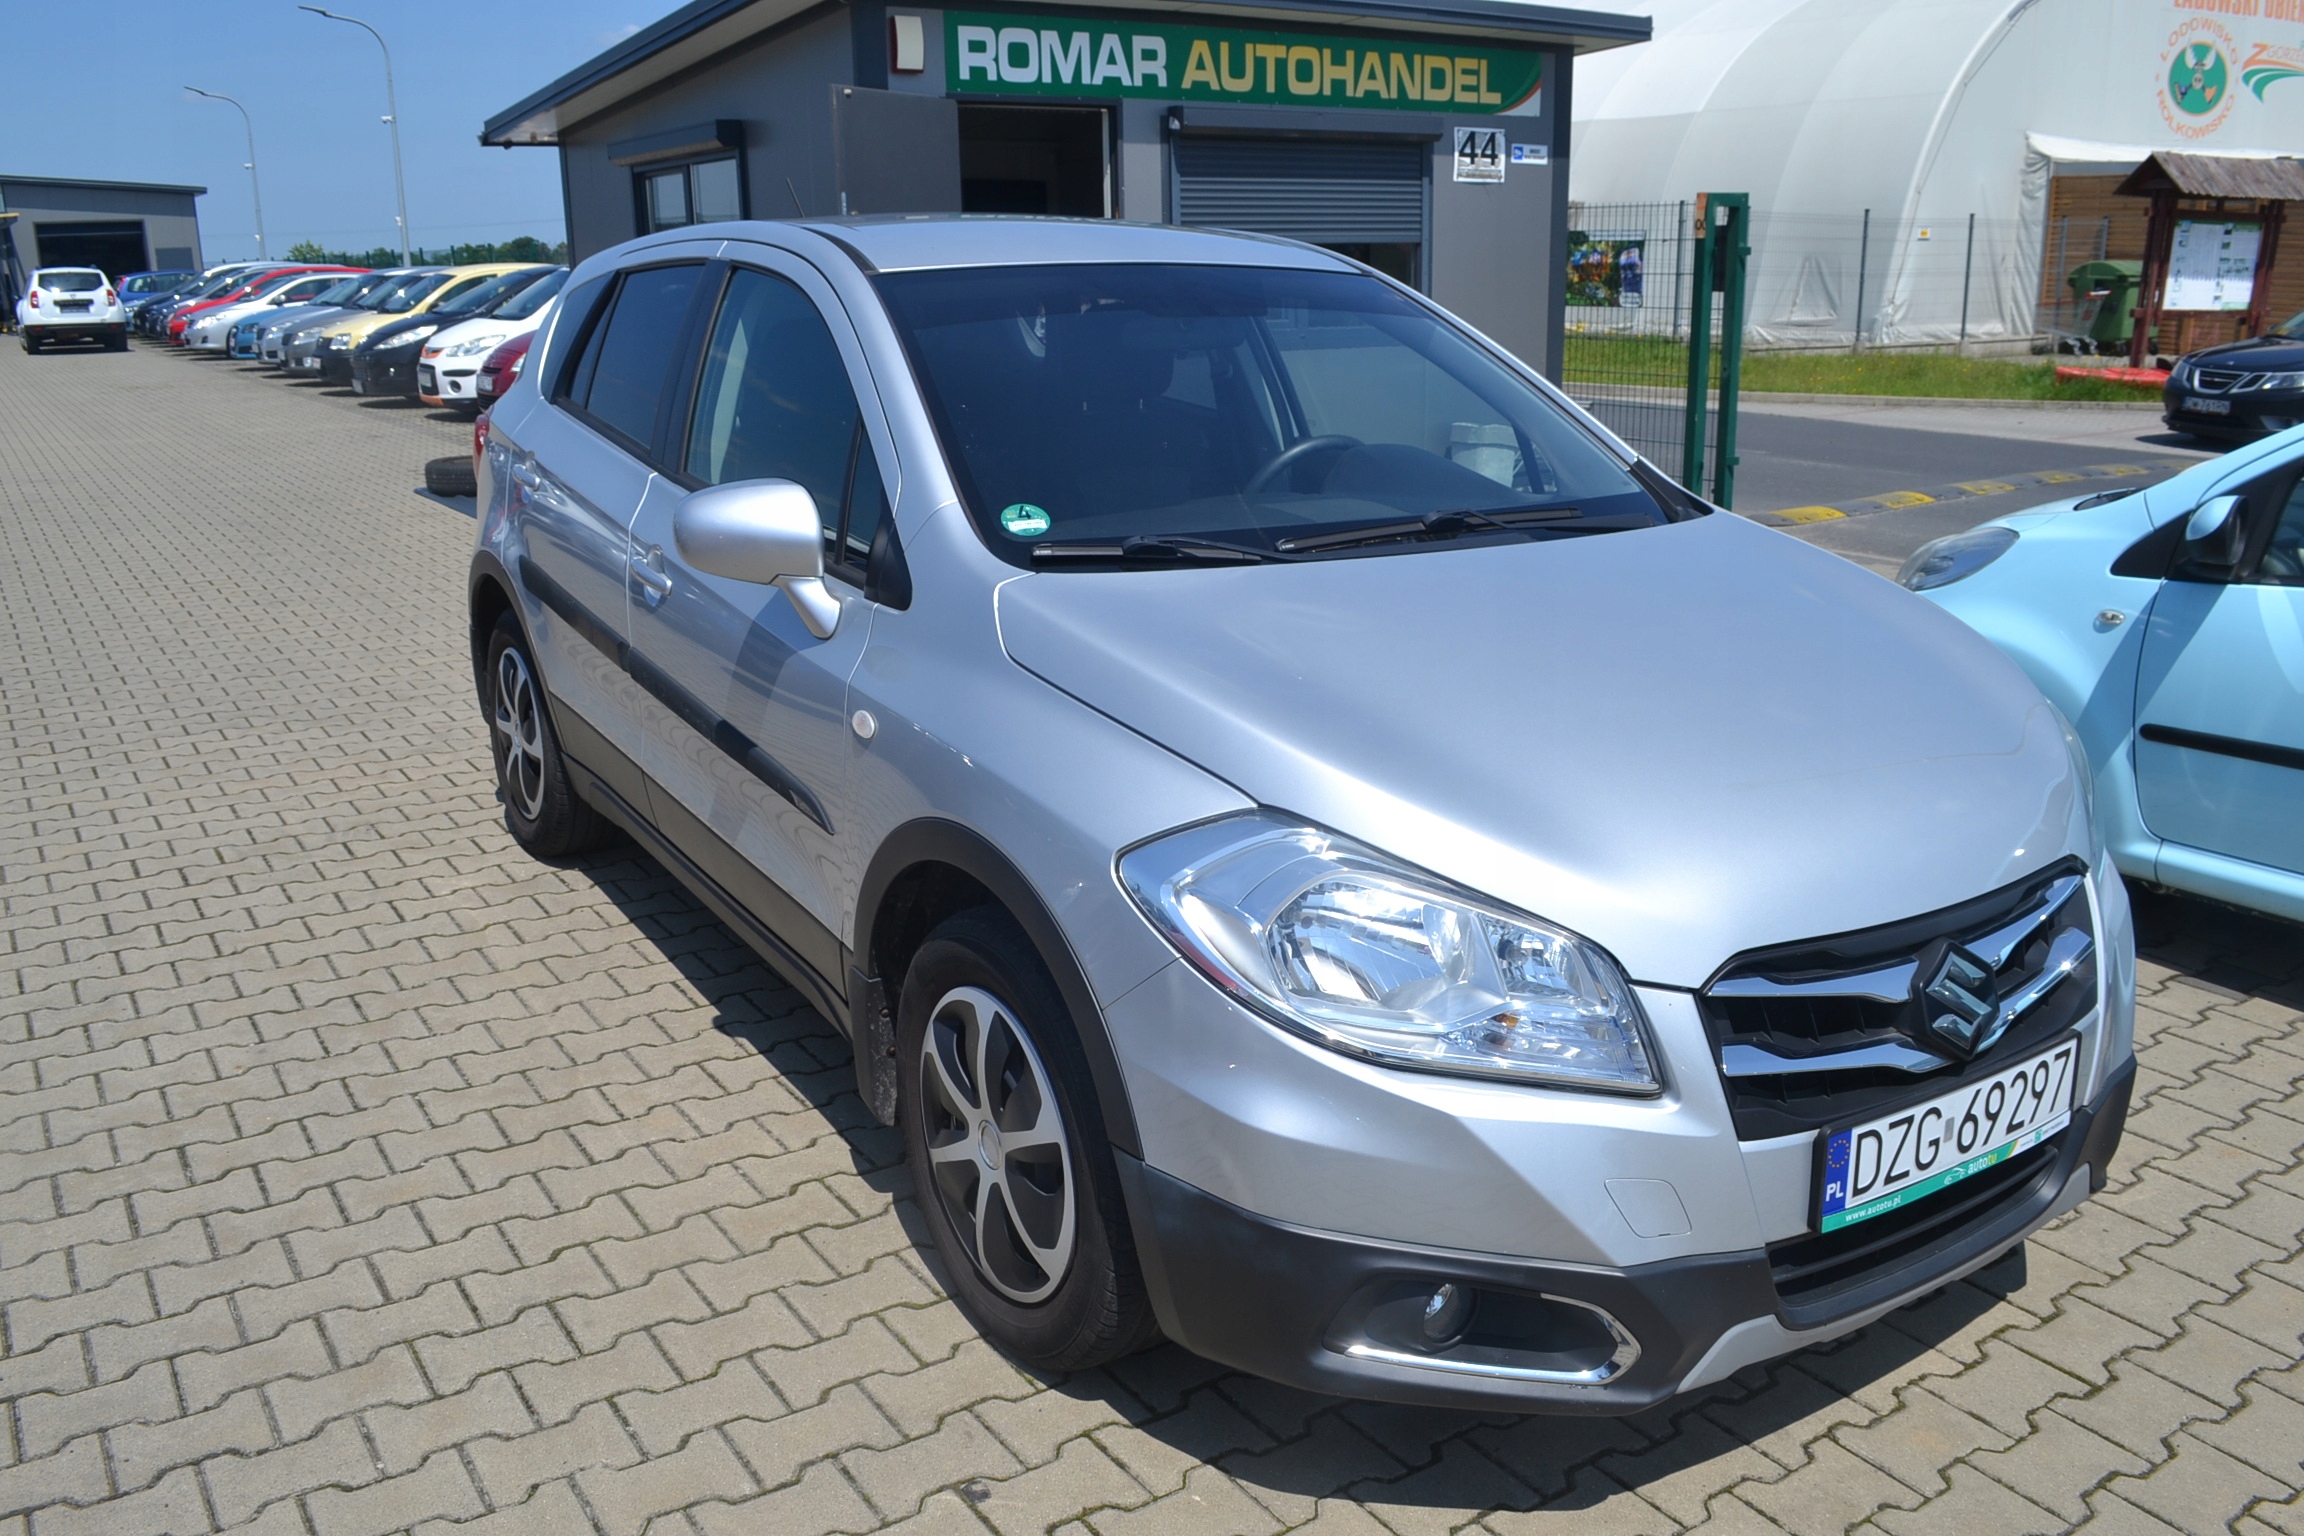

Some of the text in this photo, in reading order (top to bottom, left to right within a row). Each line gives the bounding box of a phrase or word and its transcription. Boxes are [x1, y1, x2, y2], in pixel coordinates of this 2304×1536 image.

[957, 25, 1502, 105] ROMAR AUTOHANDEL
[1459, 131, 1498, 166] 44
[1851, 1047, 2072, 1198] DZG 69297
[1967, 1153, 1998, 1174] autotu
[1825, 1181, 1844, 1202] PL
[1845, 1195, 1902, 1222] www.autotu.pl
